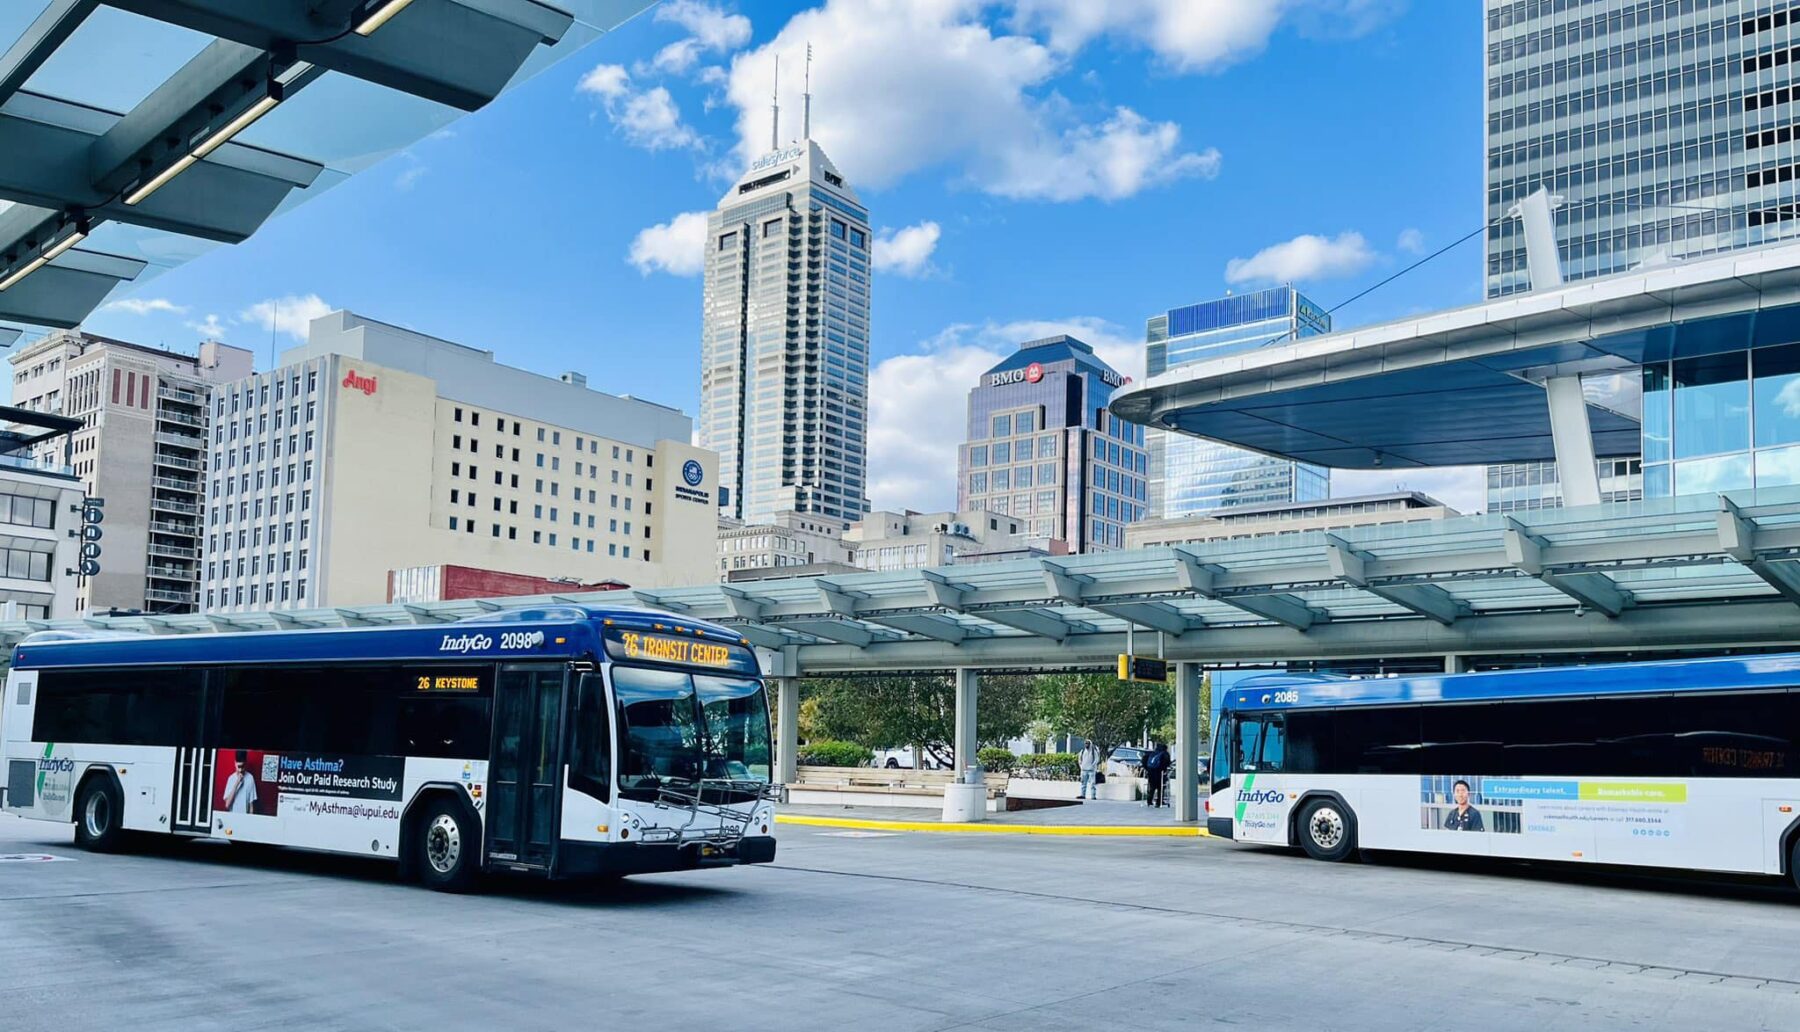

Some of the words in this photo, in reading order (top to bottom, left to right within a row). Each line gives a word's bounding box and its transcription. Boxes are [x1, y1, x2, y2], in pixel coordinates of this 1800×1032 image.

[752, 147, 801, 171] salesforce
[342, 369, 377, 396] Angi
[991, 370, 1024, 387] BMO
[1102, 369, 1125, 388] BMO
[440, 634, 493, 653] IndyGo
[500, 632, 531, 649] 2098
[643, 636, 689, 662] TRANSIT
[691, 643, 729, 666] CENTER
[417, 676, 430, 689] 26
[435, 677, 478, 689] KEYSTONE
[1274, 690, 1299, 703] 2085
[39, 756, 75, 774] IndyGo
[280, 756, 303, 770] Have
[304, 757, 344, 772] Asthma?
[278, 771, 295, 784] Join
[296, 772, 312, 785] Our
[313, 773, 331, 786] Paid
[333, 774, 370, 789] Research
[372, 776, 397, 794] Study
[1493, 785, 1540, 794] Extraordinary
[1237, 789, 1285, 805] IndyGo
[309, 801, 399, 820] MyAsthma@iupui.edu
